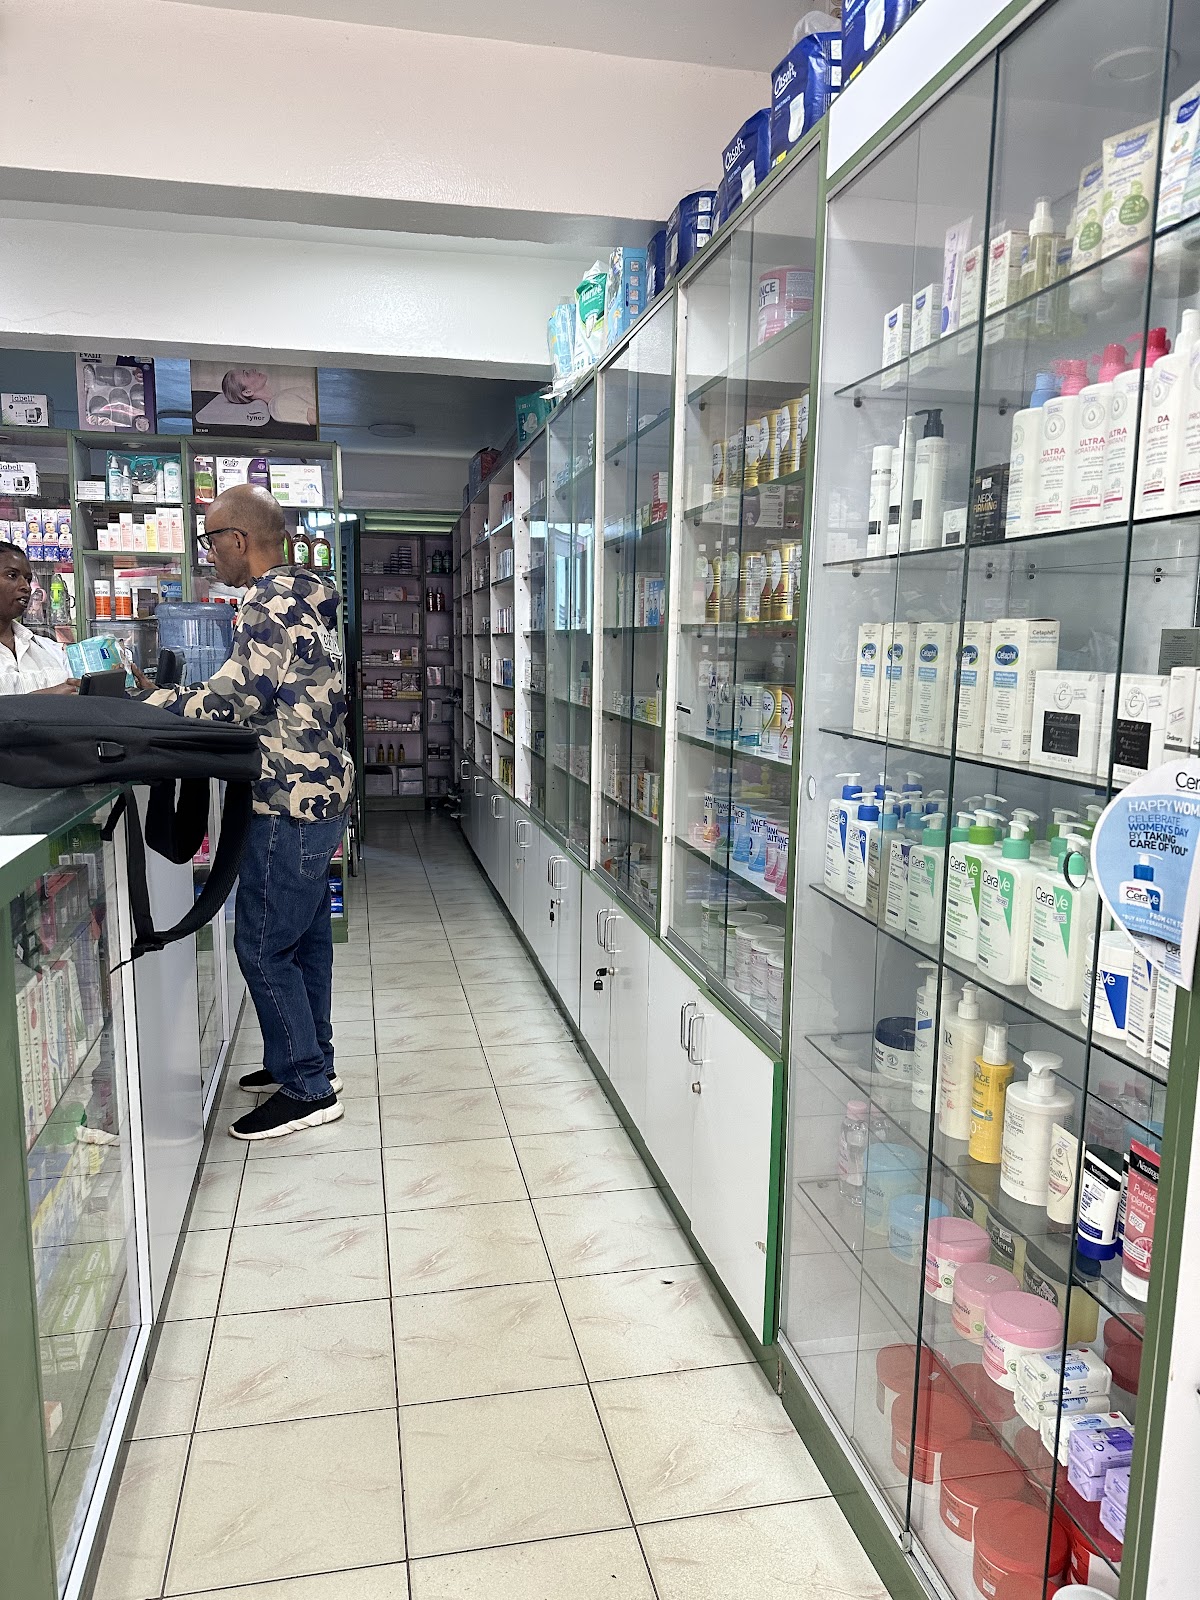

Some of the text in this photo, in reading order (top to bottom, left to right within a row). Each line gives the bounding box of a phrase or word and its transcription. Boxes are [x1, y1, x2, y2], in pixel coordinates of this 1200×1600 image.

[1079, 437, 1106, 447] ULTRA
[1042, 447, 1066, 457] ULTRA
[1128, 800, 1172, 812] HAPPY
[1128, 814, 1181, 827] CELEBRATE
[1128, 823, 1189, 837] WOMEN'S DAY
[1129, 831, 1176, 844] BY TAKING
[1129, 839, 1157, 850] CARE
[1158, 842, 1170, 852] OF
[911, 855, 935, 871] CeraVe
[949, 855, 979, 876] CeraVe
[982, 869, 1011, 892] CeraVe
[1035, 886, 1069, 910] CeraVe
[1126, 889, 1160, 905] CeraVe
